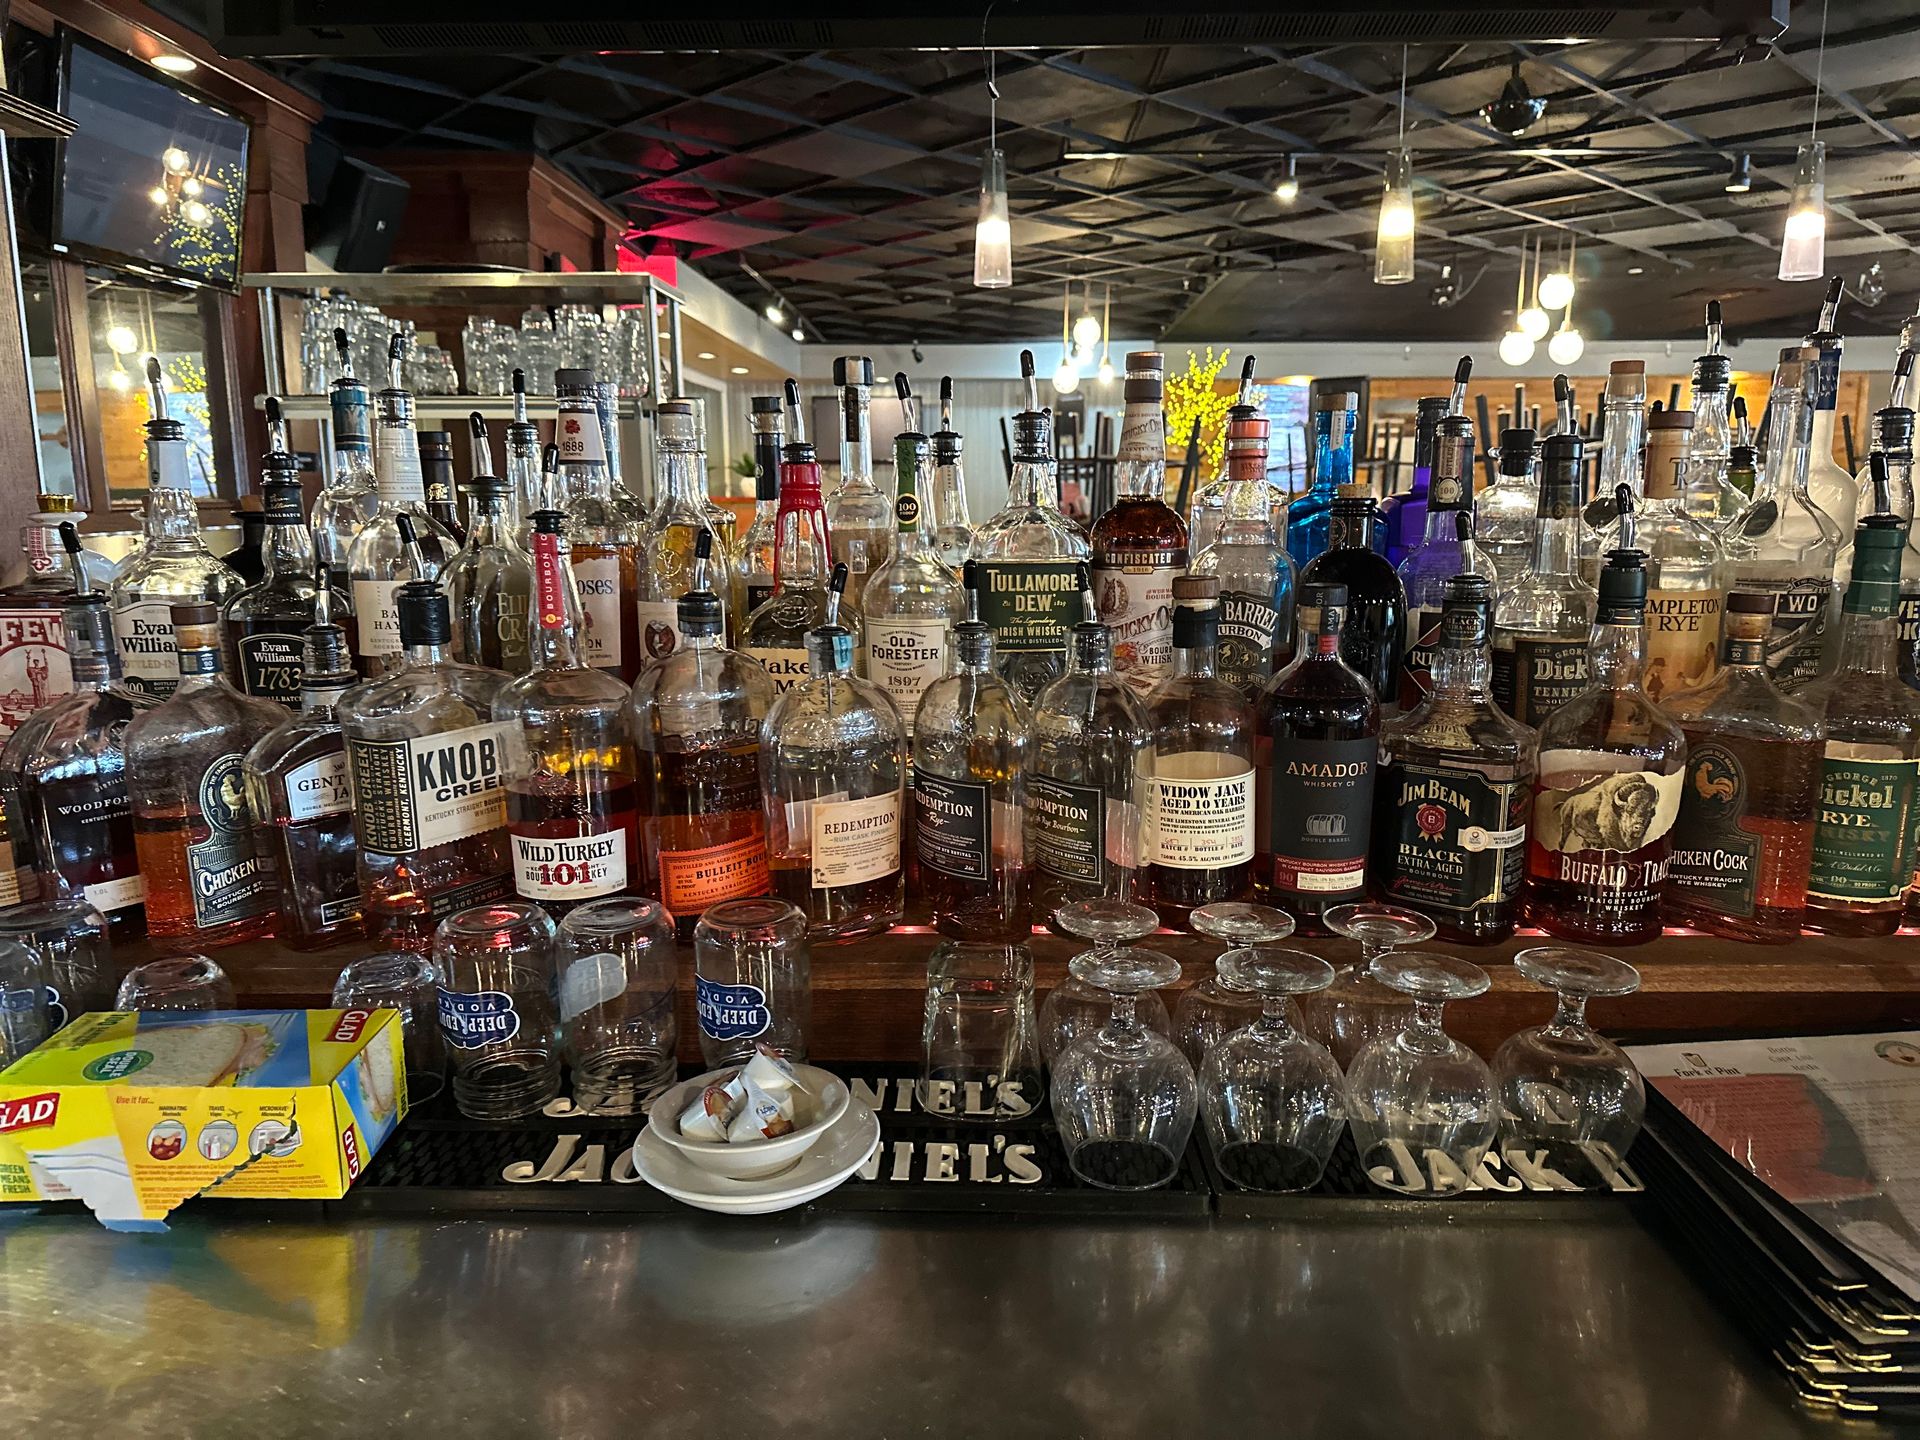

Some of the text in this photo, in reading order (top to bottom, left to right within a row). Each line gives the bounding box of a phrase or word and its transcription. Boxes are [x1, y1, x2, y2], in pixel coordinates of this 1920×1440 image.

[899, 502, 917, 511] 100
[1105, 552, 1175, 565] CONFISCATED
[544, 552, 555, 610] BOURBON
[577, 579, 616, 596] oses
[987, 569, 1079, 592] TULLAMORE
[1225, 600, 1279, 633] BARREL
[1658, 615, 1700, 632] RYE
[0, 617, 65, 647] FEW
[999, 626, 1068, 637] IRISH WHISKEY
[1219, 625, 1263, 642] URBON
[120, 637, 178, 653] Willia
[261, 642, 291, 652] Evan
[890, 635, 916, 648] OLD
[253, 652, 301, 663] Williams
[872, 645, 938, 660] FORESTER
[1534, 658, 1588, 681] Dick
[257, 667, 302, 691] 1783
[888, 675, 921, 687] 1897
[380, 748, 392, 796] WHISKEY
[395, 747, 408, 795] KENTUCKY
[417, 739, 497, 792] KNOB
[1285, 760, 1369, 778] AMADOR
[1303, 780, 1344, 788] WHISKEY
[1826, 771, 1878, 786] GEORGE
[356, 746, 378, 846] KNOB CREEK
[372, 748, 389, 849] KENTUCKY STRAIGHT
[1160, 781, 1246, 799] WIDOW JANE
[1397, 779, 1472, 818] JIM BEAM
[58, 795, 130, 816] WOODFOR
[1160, 794, 1246, 809] AGED 10 YEARS
[81, 814, 112, 824] KENTUCKY
[425, 801, 483, 823] KENTUCKY STRAIGHT
[929, 811, 944, 827] Rye
[1821, 810, 1872, 828] RYE
[386, 800, 398, 849] BOURBON
[402, 799, 413, 847] CLERMONT,
[824, 811, 896, 835] REDEMPTION
[1052, 820, 1080, 834] Bourbon
[851, 833, 869, 841] CASK
[1231, 841, 1243, 849] DATE
[518, 839, 615, 863] WILD TURKEY
[1161, 843, 1182, 851] BATCH
[1399, 843, 1464, 864] BLACK
[717, 856, 731, 864] AGED
[1277, 857, 1301, 866] KENTUCKY
[1397, 854, 1464, 875] EXTRA-AGED
[1670, 849, 1749, 871] HICKEN COCK
[199, 858, 256, 897] CHICKEN
[539, 862, 593, 885] 101
[696, 861, 743, 880] BULLEIT
[1409, 868, 1450, 880] BOURBON
[1561, 855, 1627, 888] BUFFALO
[1643, 856, 1670, 887] TRAC
[212, 885, 251, 905] KENTUCKY
[216, 892, 253, 910] BOURBON
[683, 887, 719, 898] KENTUCKY
[1577, 895, 1626, 905] STRAIGHT
[1603, 890, 1649, 898] KENTUCKY
[1605, 904, 1644, 912] WHISKEY
[335, 1010, 369, 1042] GLAD
[468, 1014, 507, 1033] DEEP
[721, 1009, 758, 1025] DEEP
[100, 1056, 122, 1074] SEAL
[109, 1051, 138, 1078] DOUBLE
[1673, 1066, 1741, 1078] Fork Pint
[115, 1095, 131, 1104] Use
[850, 1074, 1033, 1116] NIEL'S
[344, 1129, 360, 1180] GLAD
[1368, 1138, 1585, 1192] JACK
[2, 1184, 32, 1194] FRESH
